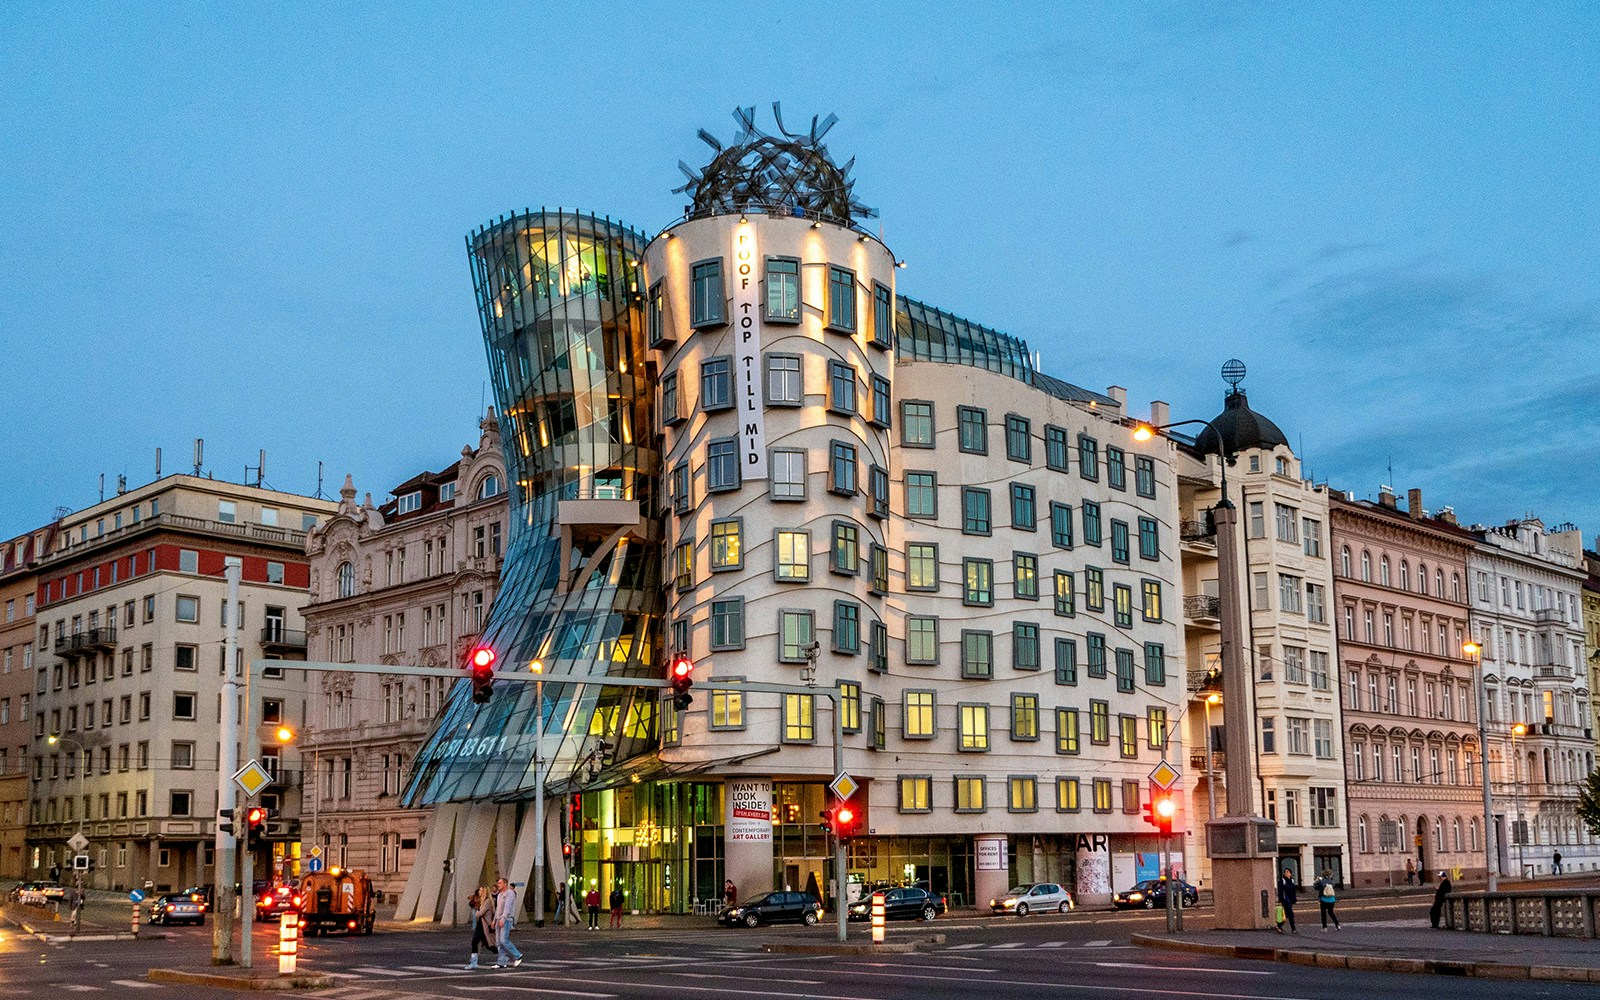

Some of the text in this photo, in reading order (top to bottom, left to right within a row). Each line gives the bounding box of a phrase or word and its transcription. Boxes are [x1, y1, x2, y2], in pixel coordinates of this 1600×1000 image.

[746, 424, 758, 464] MID
[732, 784, 758, 792] WANT
[732, 792, 756, 800] LOOK
[733, 801, 766, 810] INSIDE?
